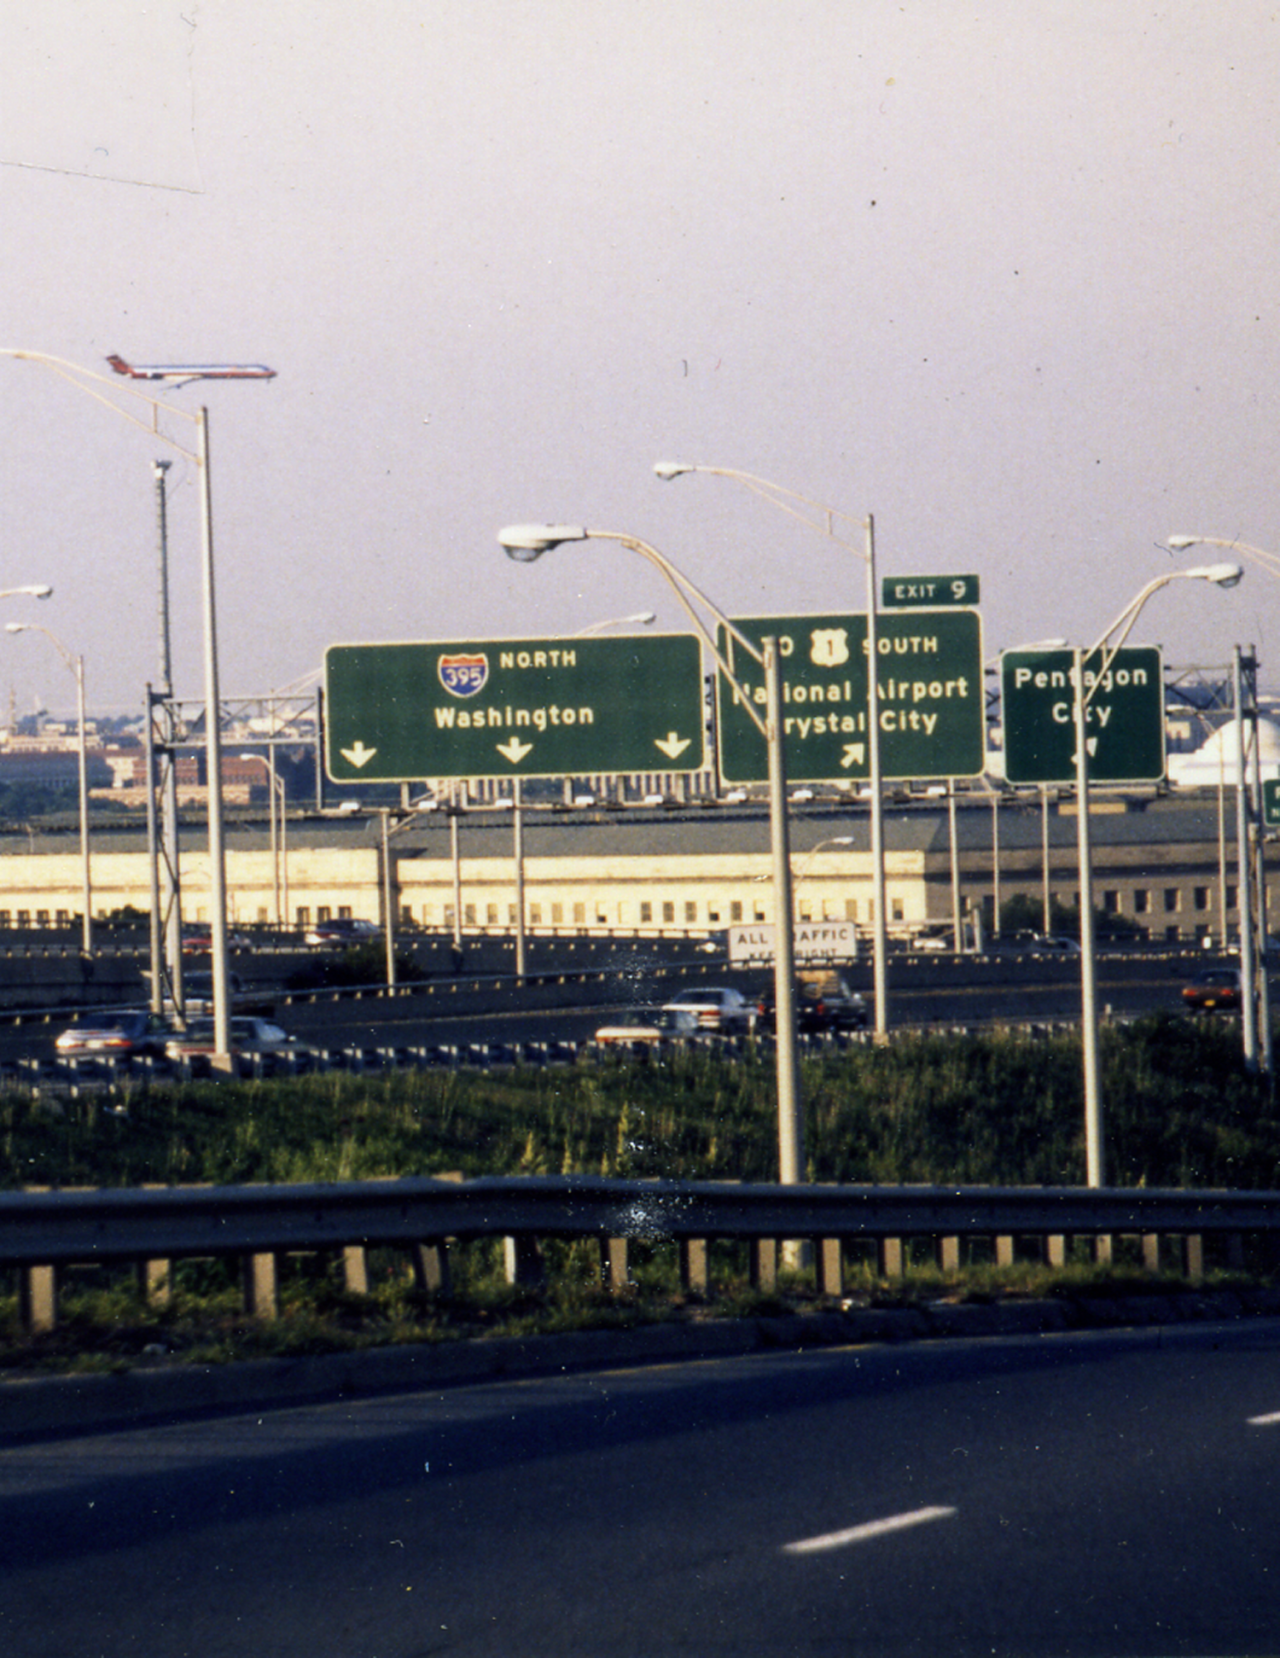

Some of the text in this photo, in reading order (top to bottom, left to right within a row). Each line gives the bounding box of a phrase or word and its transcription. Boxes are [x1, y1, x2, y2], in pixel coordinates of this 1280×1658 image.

[895, 580, 966, 599] EXIT 9
[827, 639, 834, 657] 1
[500, 650, 576, 669] NORTH
[445, 667, 482, 688] 395
[434, 705, 595, 732] Washington
[765, 709, 938, 739] rystal City
[738, 928, 848, 944] ALL AFFIC
